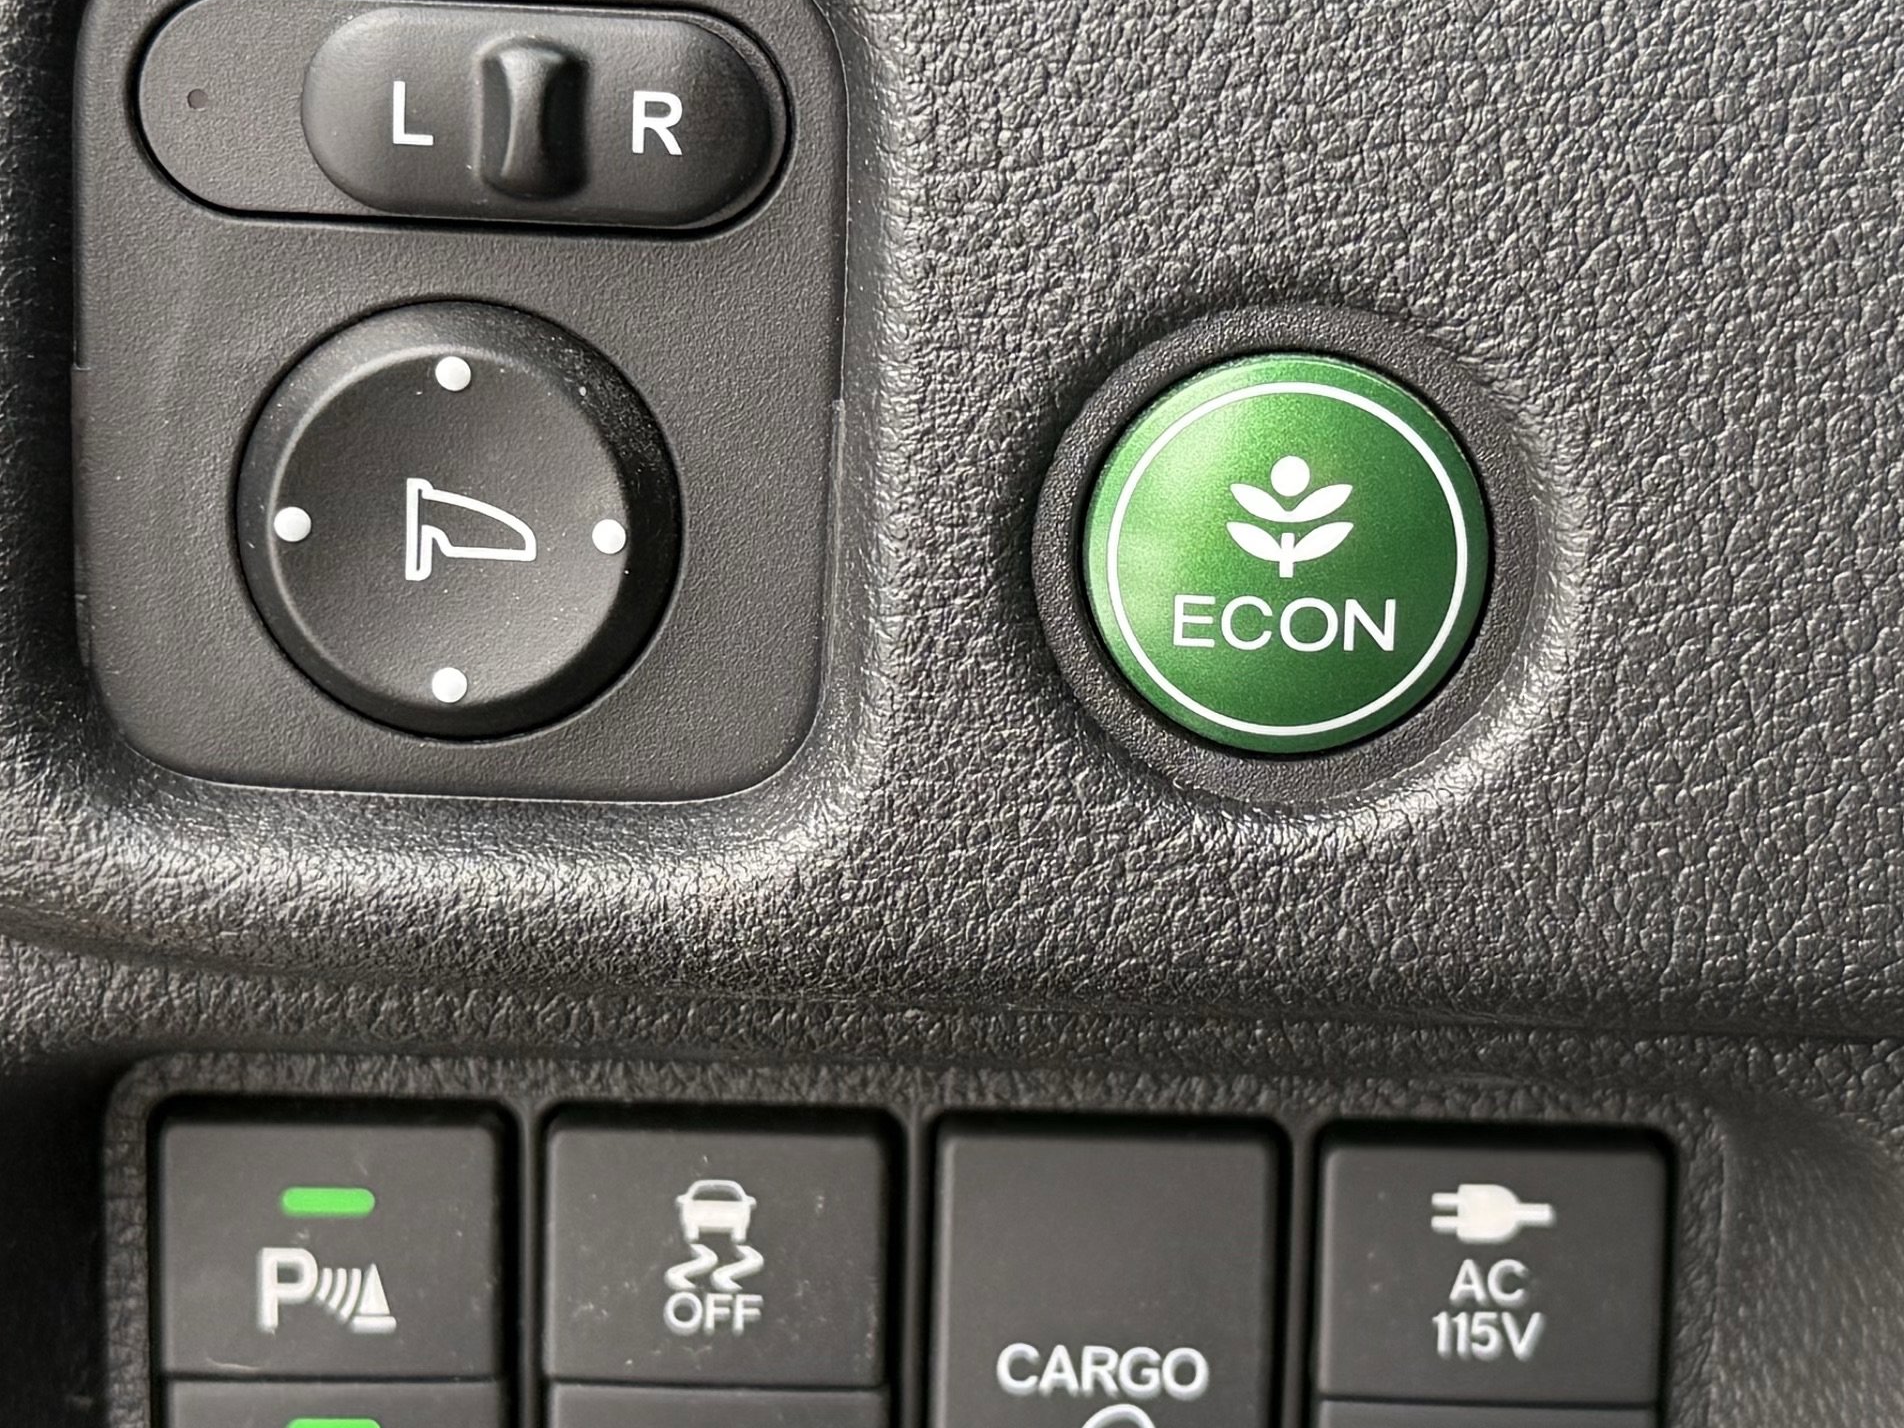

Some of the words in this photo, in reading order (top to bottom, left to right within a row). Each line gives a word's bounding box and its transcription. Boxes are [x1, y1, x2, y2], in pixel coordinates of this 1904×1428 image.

[391, 80, 433, 147] L
[632, 89, 683, 155] R
[1173, 597, 1397, 653] ECON
[259, 1248, 318, 1334] P
[1449, 1259, 1527, 1307] AC
[664, 1292, 763, 1336] OFF
[1432, 1311, 1543, 1361] 115V
[997, 1343, 1209, 1400] CARGO
